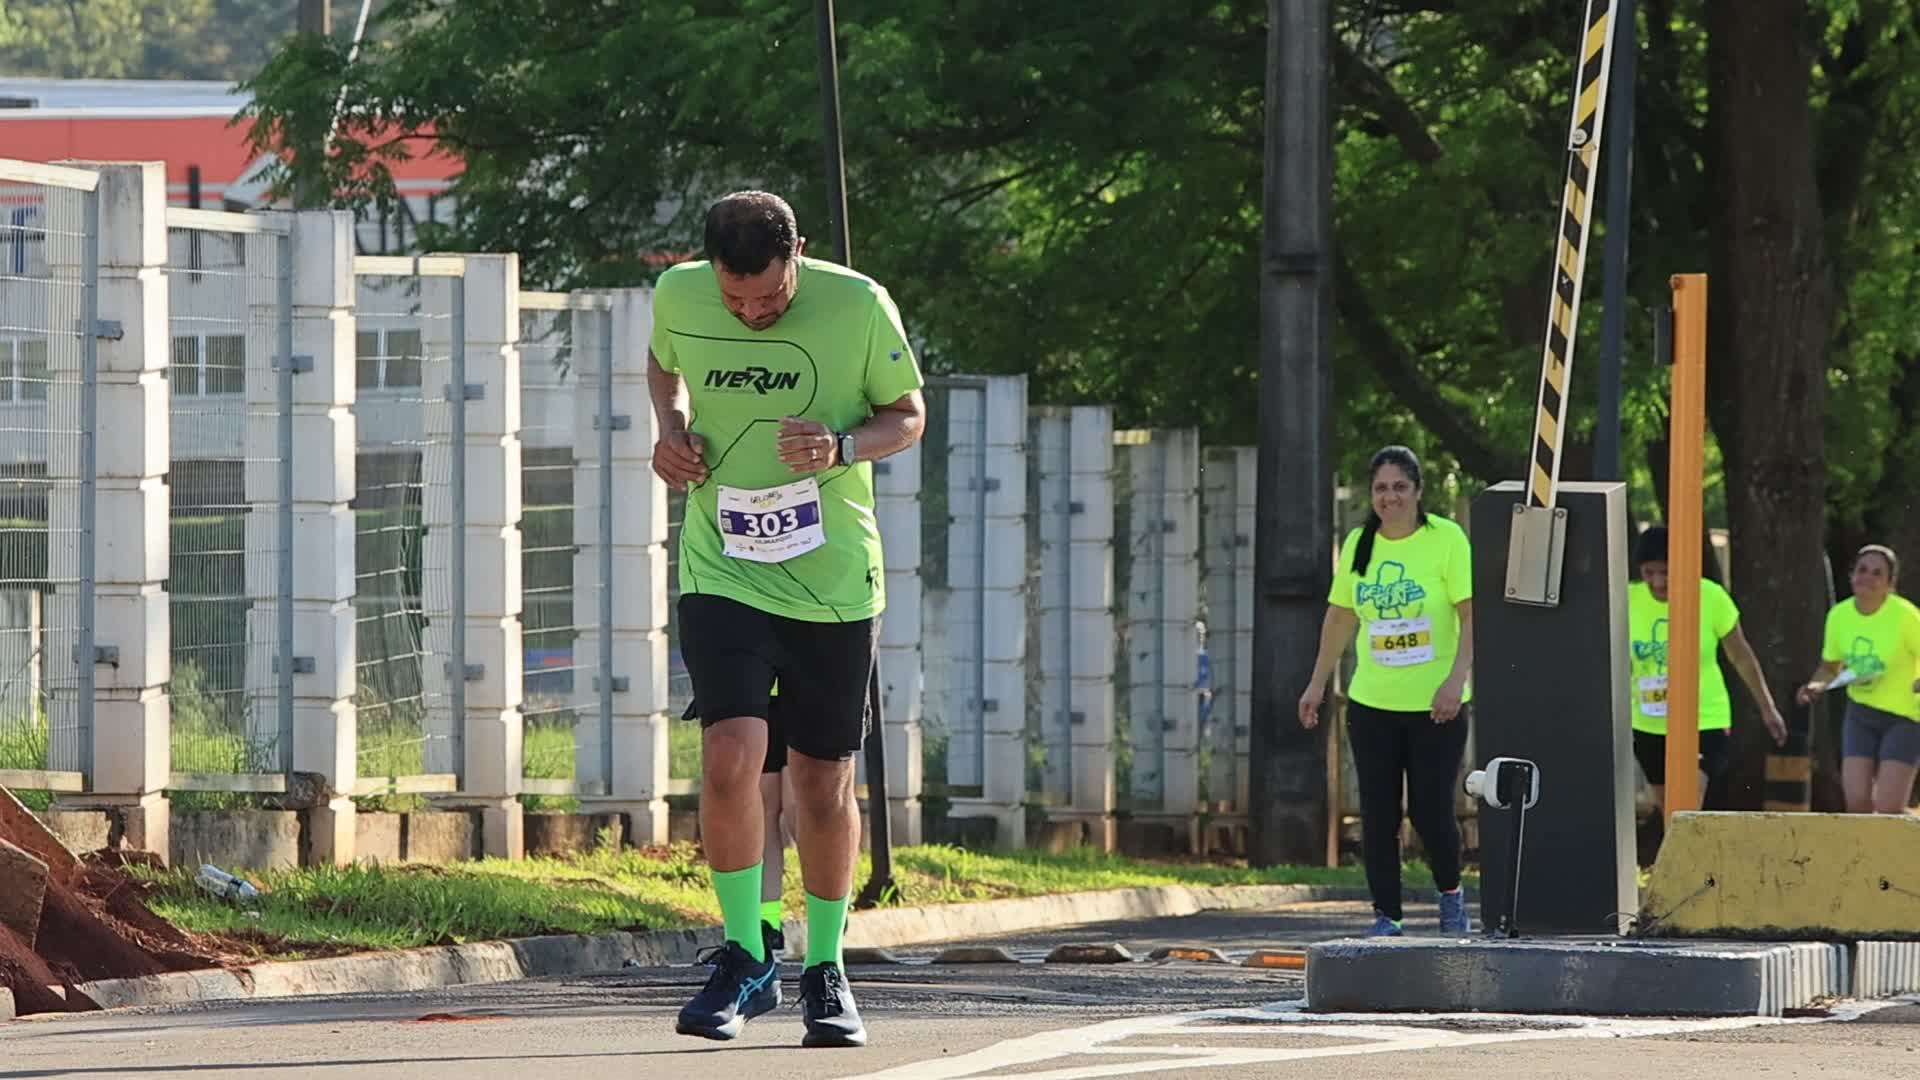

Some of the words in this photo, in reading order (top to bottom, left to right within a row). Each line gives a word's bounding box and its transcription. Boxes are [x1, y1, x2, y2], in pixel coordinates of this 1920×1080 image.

[704, 366, 800, 395] IVERUN
[743, 508, 799, 537] 303
[1384, 633, 1418, 650] 648
